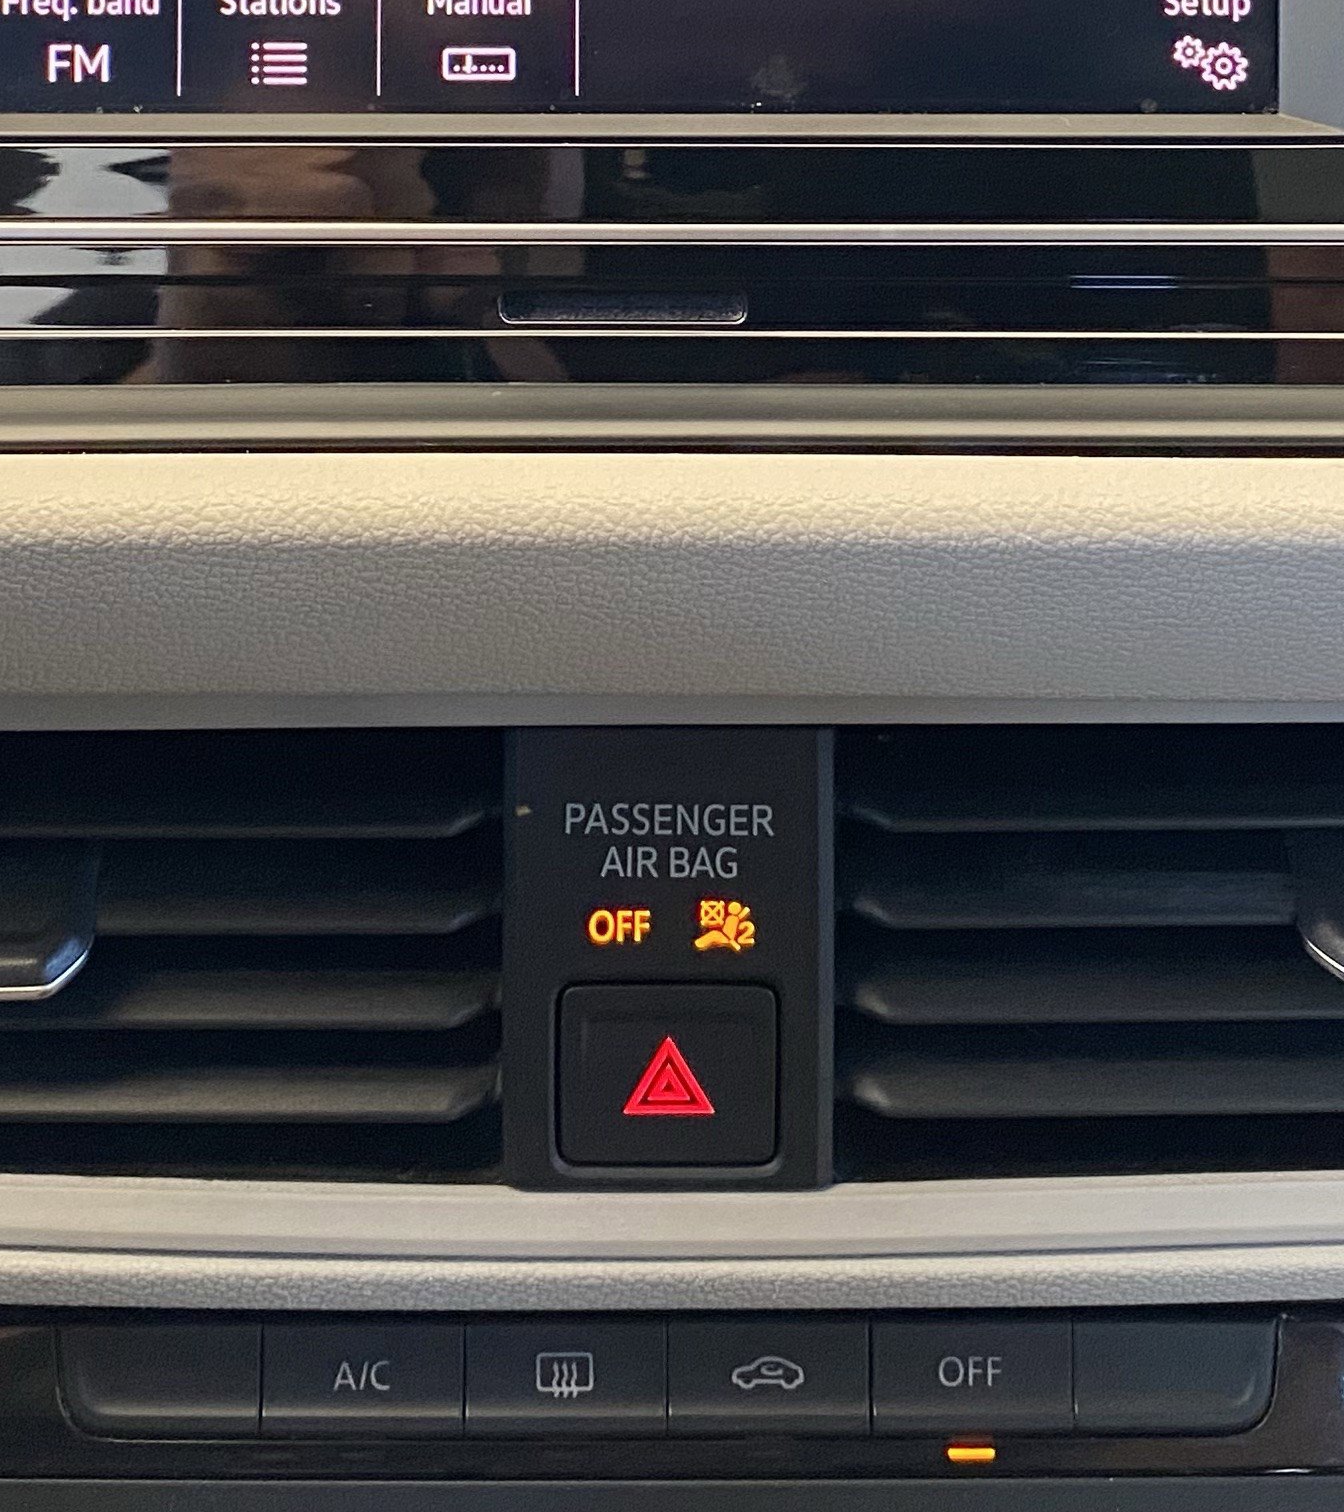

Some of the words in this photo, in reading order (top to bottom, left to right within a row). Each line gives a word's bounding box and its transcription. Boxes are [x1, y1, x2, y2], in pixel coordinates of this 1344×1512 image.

[46, 42, 111, 84] FM
[564, 801, 776, 838] PASSENGER
[599, 845, 660, 879] AIR
[668, 845, 739, 880] BAG
[587, 908, 652, 944] OFF
[332, 1359, 391, 1392] A/C
[937, 1355, 1003, 1388] OFF
